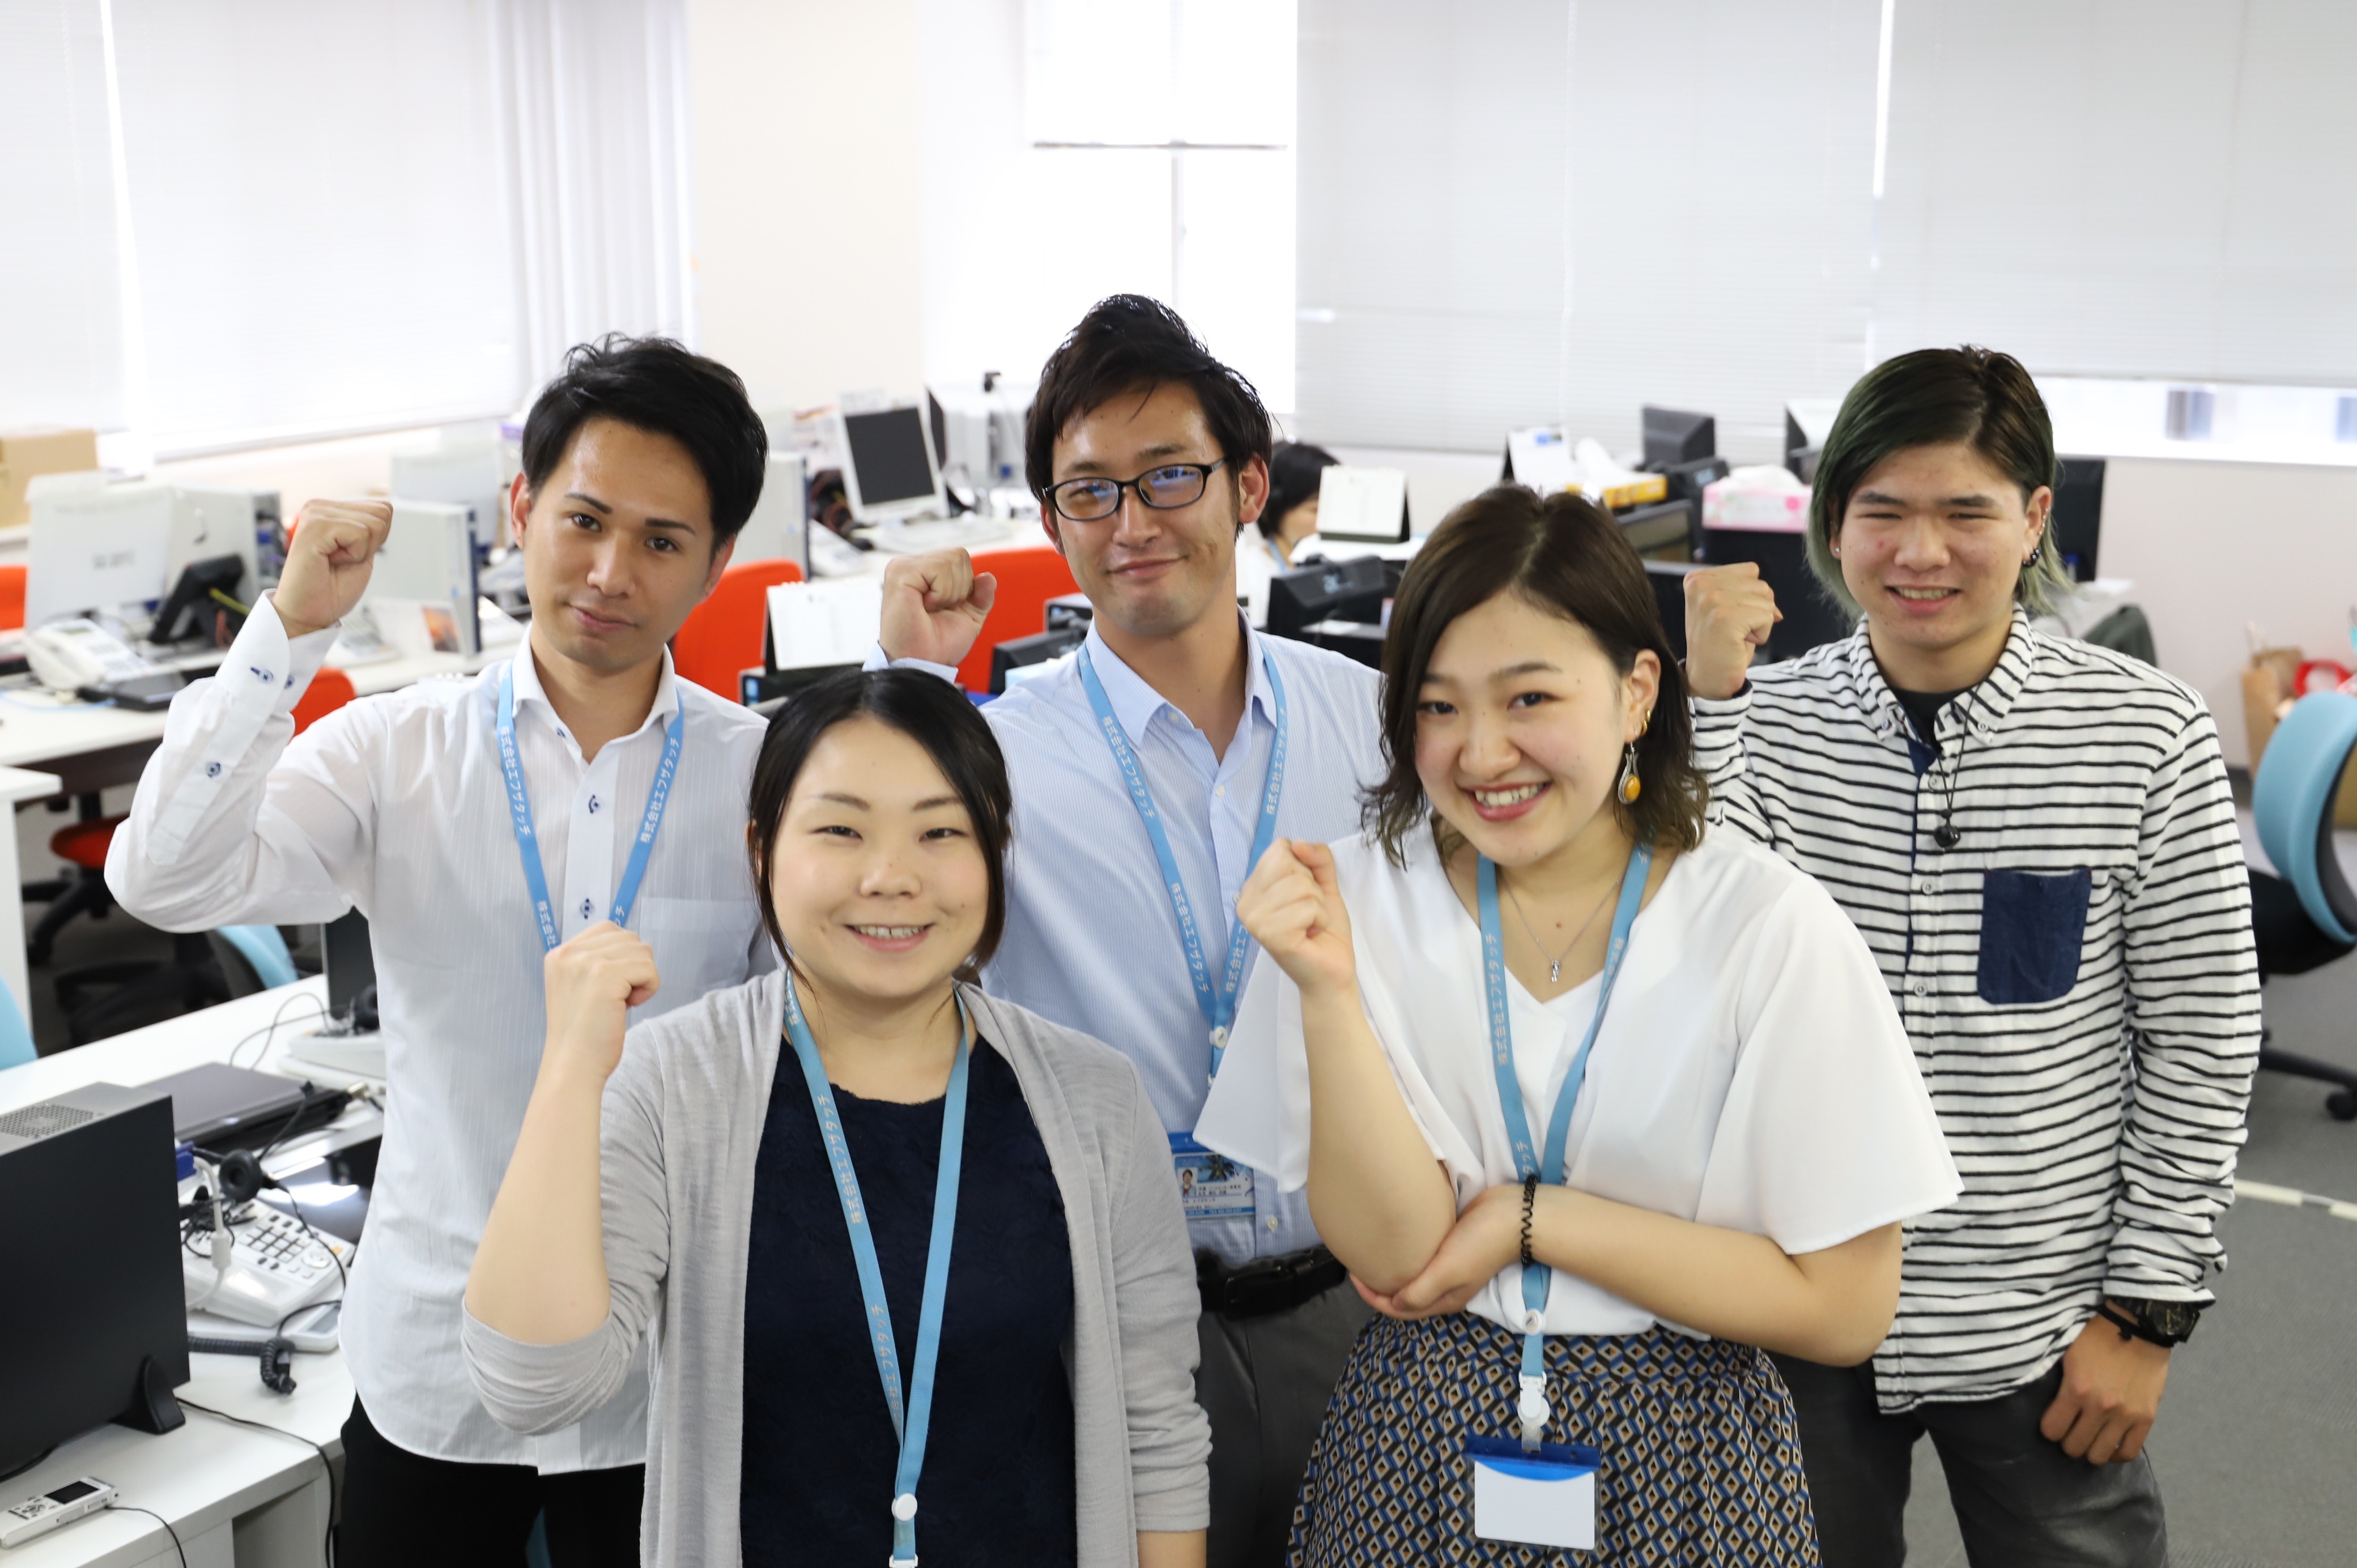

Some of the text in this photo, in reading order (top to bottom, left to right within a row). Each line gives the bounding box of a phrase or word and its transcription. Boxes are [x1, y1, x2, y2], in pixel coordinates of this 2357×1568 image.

[500, 726, 531, 836] 株式会社エフザタッチ
[640, 736, 680, 844] 株式会社エフザタッチ
[1101, 715, 1155, 819] 株式会社エフザタッチ
[1266, 706, 1289, 815] 株式会社エフザタッチ
[537, 900, 558, 951] 株式会社
[1171, 881, 1209, 994] 株式会社エフザタッチ
[1484, 933, 1509, 1066] 株式会社エフザタッチ
[816, 1093, 863, 1225] 株式会社エフザタッチ
